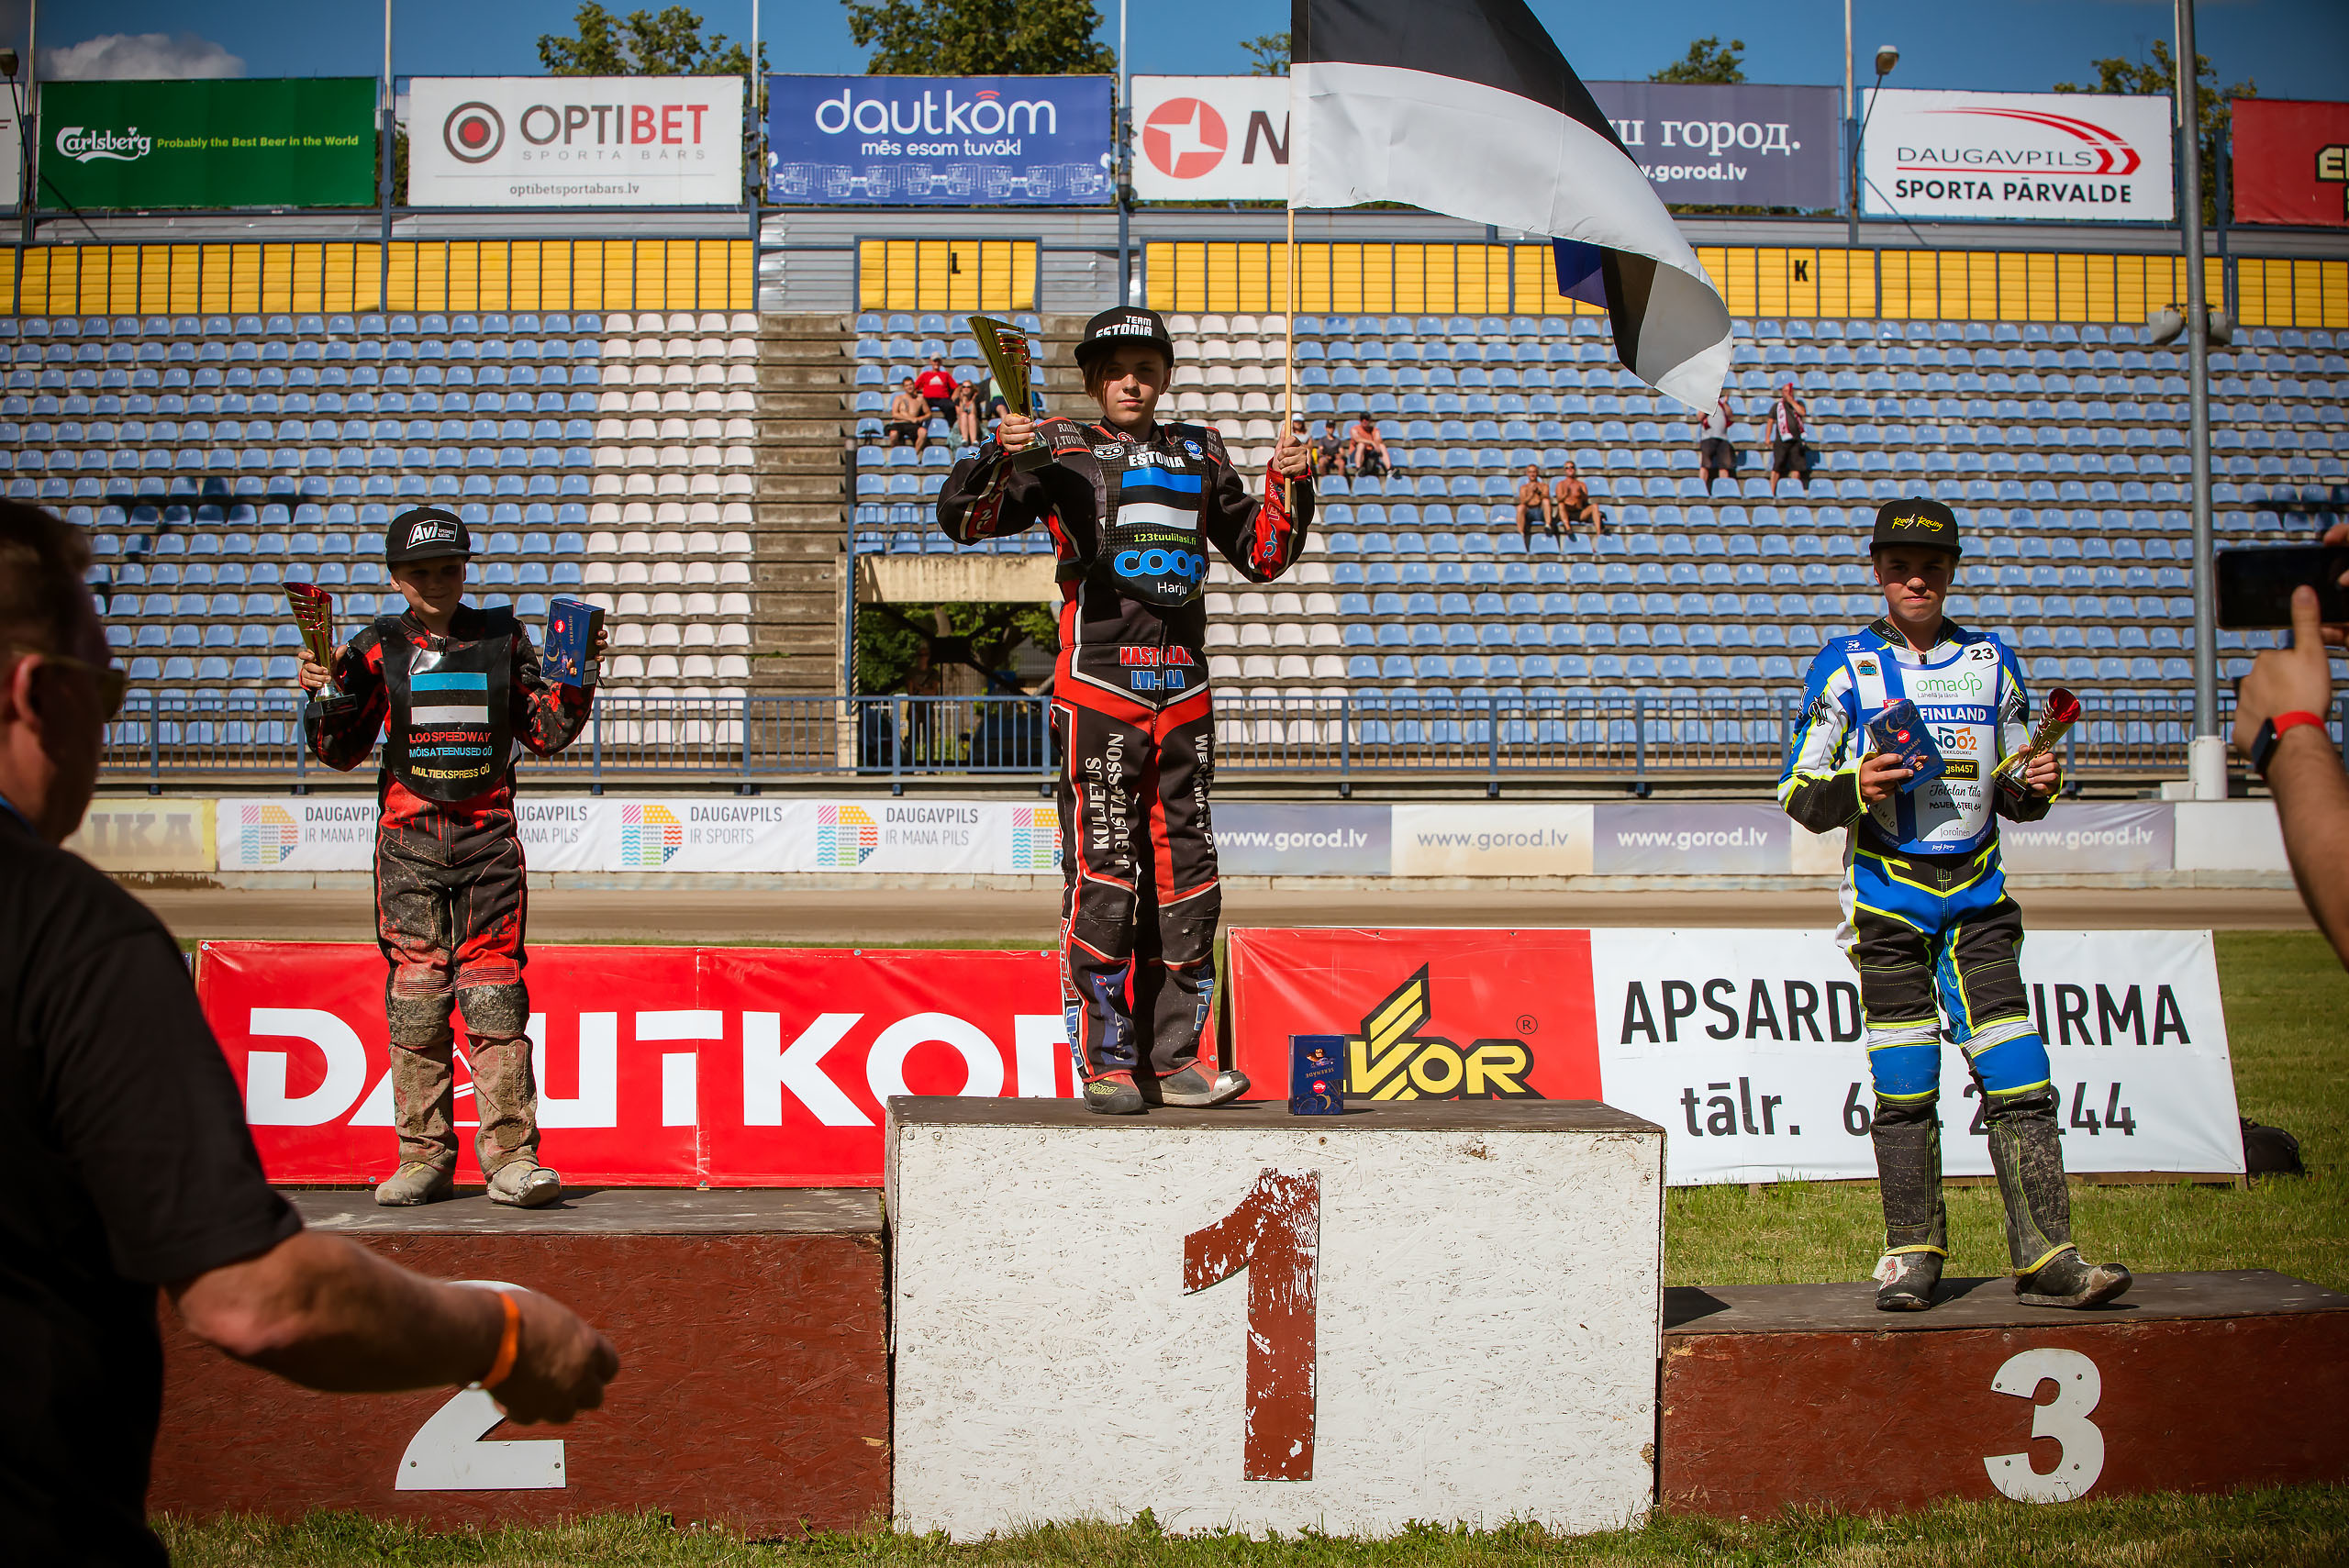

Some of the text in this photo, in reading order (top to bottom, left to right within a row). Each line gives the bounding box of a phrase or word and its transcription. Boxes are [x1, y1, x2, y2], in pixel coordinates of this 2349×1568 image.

[519, 105, 708, 145] OPTIBET
[56, 126, 152, 163] Carlsberg
[157, 136, 359, 150] Probably the Best Beer in the World
[1660, 120, 1801, 156] город.
[522, 150, 621, 161] SPORTA
[862, 139, 1021, 156] mēs esam tuvāk!
[1897, 147, 2092, 167] DAUGAVPILS
[509, 182, 640, 197] optibetsportabars.lv
[1896, 177, 2132, 203] SPORTA PĀRVALDE
[952, 252, 962, 274] L
[1794, 260, 1809, 282] K
[1125, 315, 1152, 327] TEAM
[1128, 451, 1186, 468] ESTONIA
[1133, 532, 1197, 545] 123tuulilasi.fi
[1113, 548, 1206, 584] coop
[1157, 582, 1187, 596] Harju
[1969, 648, 1995, 662] 23
[1919, 707, 1987, 722] FINLAND
[411, 765, 479, 779] MULTIEKSPRESS
[305, 806, 378, 822] DAUGAVPI
[690, 806, 783, 822] DAUGAVPILS
[885, 807, 978, 823] DAUGAVPILS
[320, 828, 354, 842] MANA
[552, 828, 579, 842] PILS
[690, 828, 754, 844] IR SPORTS
[885, 829, 969, 845] IR MANA PILS
[1214, 828, 1368, 852] www.gorod.lv
[1417, 828, 1569, 851] www.gorod.lv
[1617, 827, 1768, 851] www.gorod.lv
[2009, 826, 2154, 851] www.gorod.lv
[1620, 978, 1864, 1046] APSARD
[1680, 1076, 1800, 1138] tālr.
[1183, 1167, 1320, 1482] 1
[1983, 1348, 2105, 1505] 3
